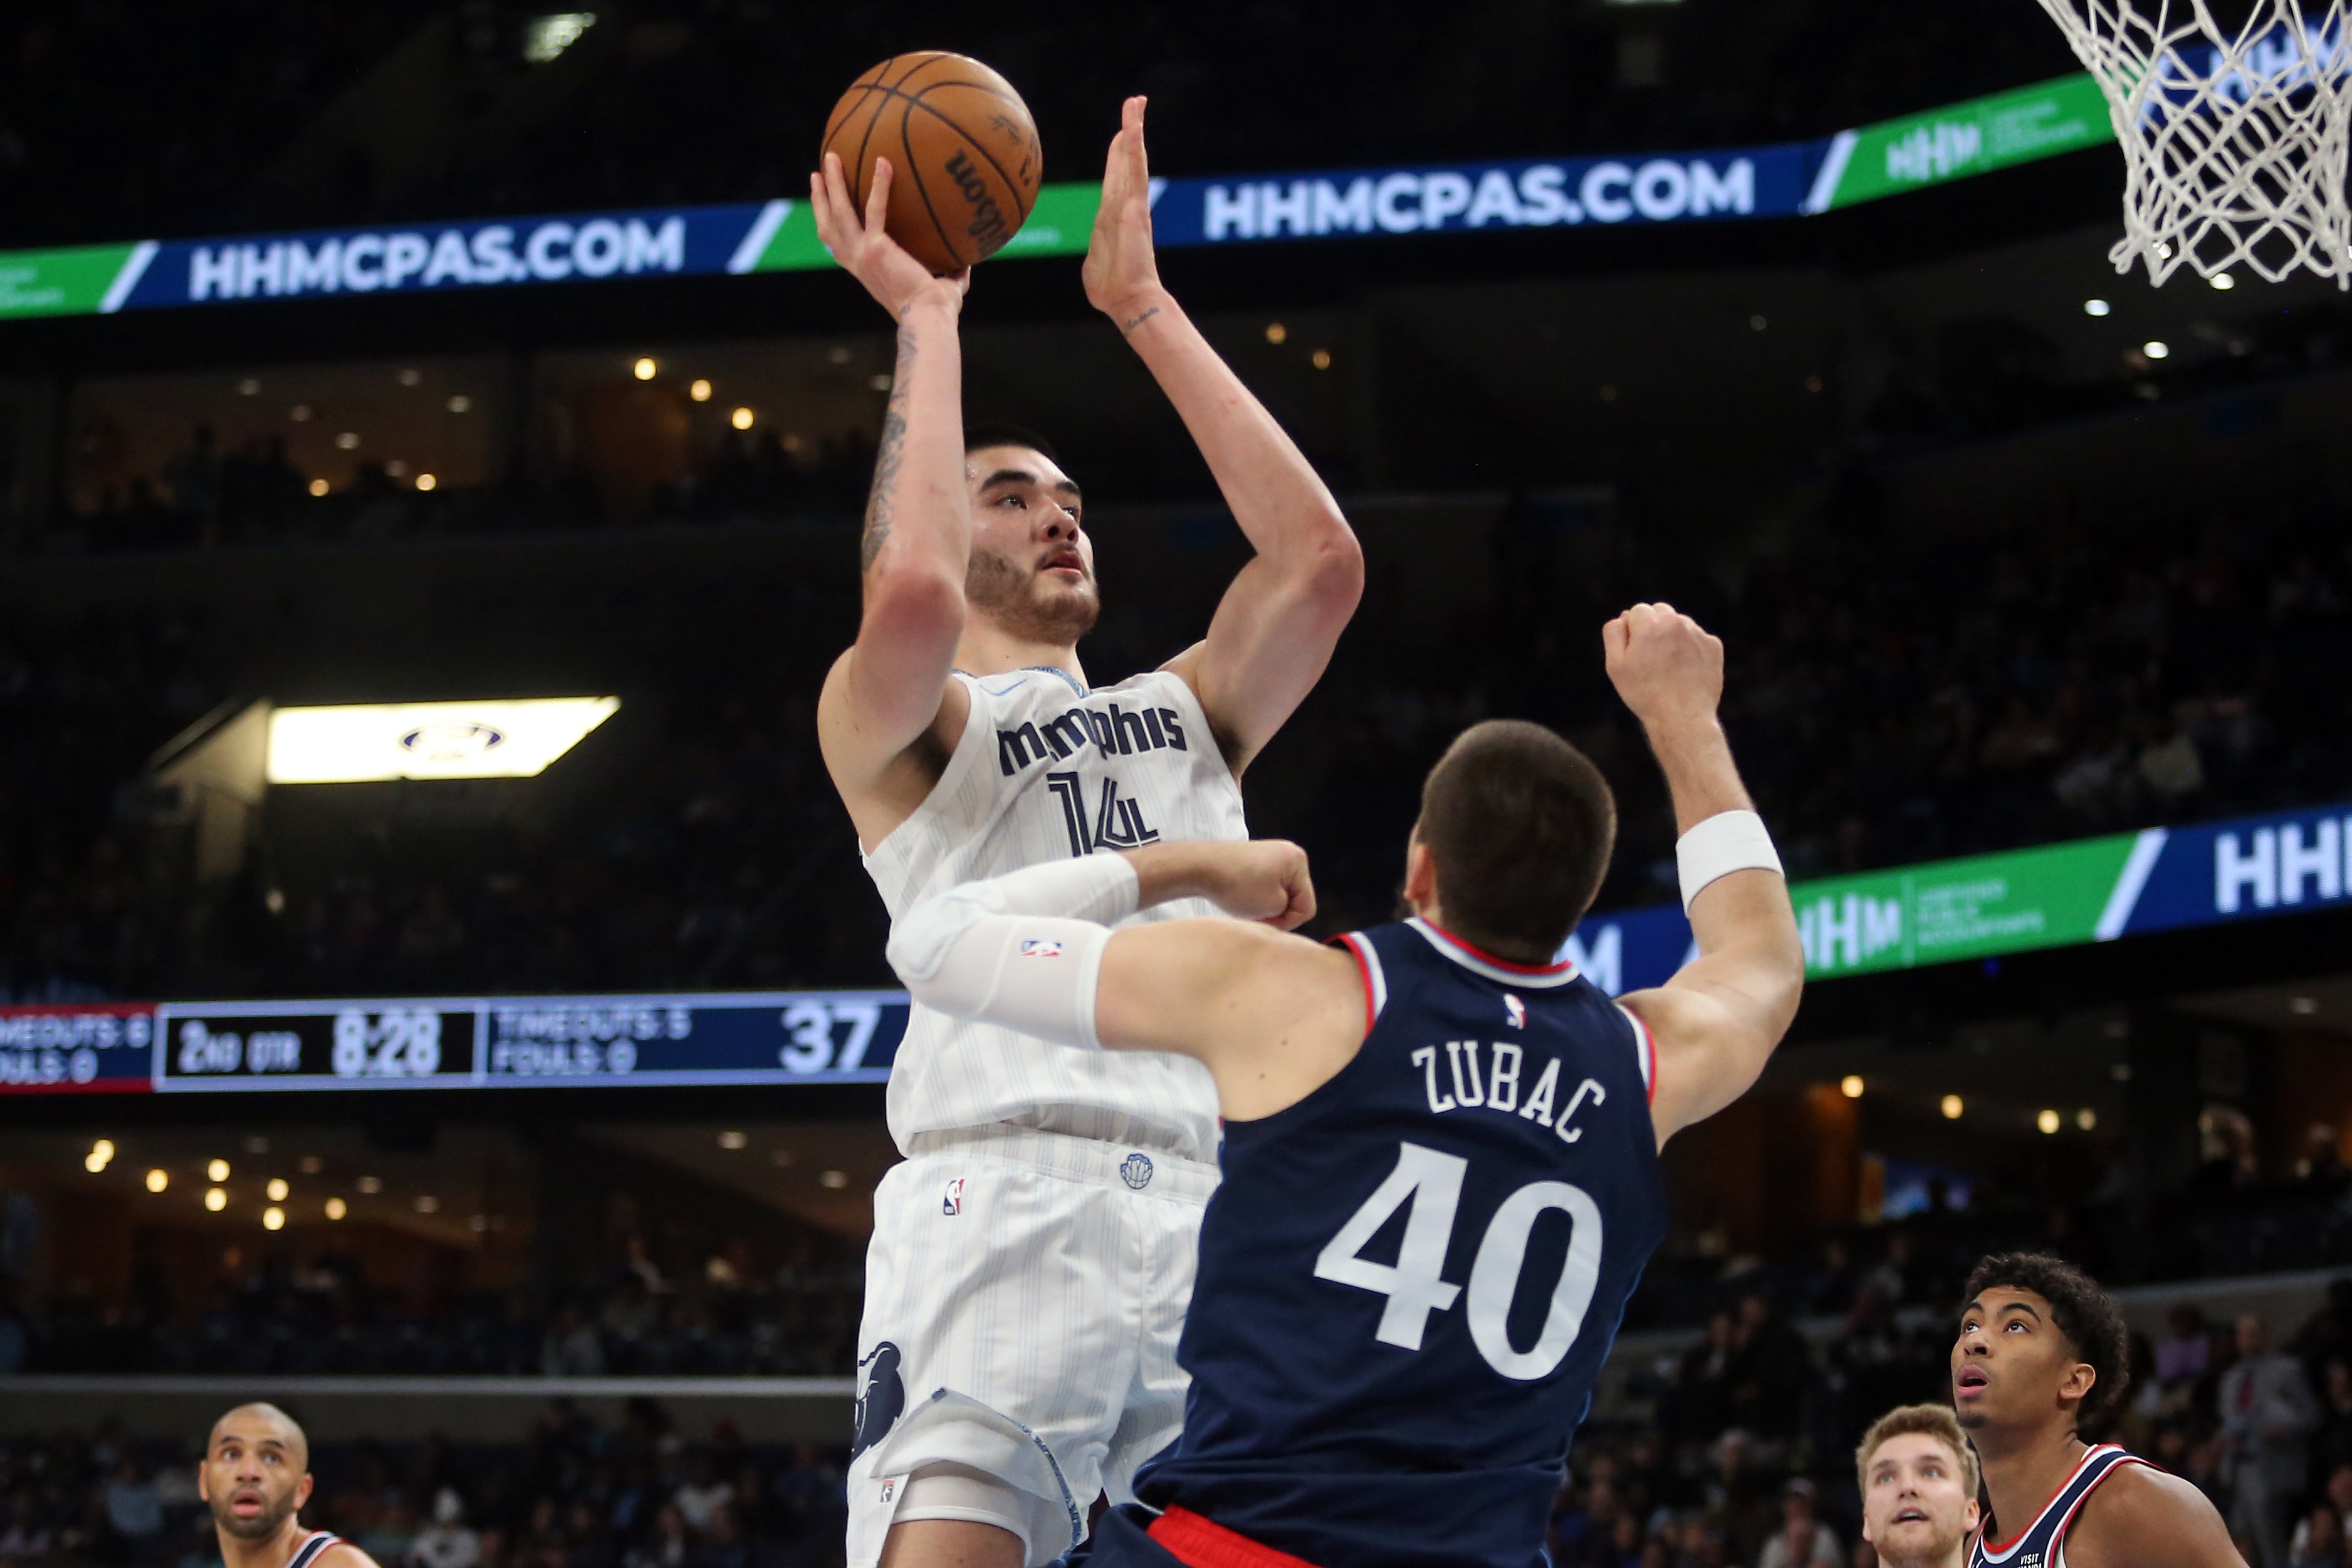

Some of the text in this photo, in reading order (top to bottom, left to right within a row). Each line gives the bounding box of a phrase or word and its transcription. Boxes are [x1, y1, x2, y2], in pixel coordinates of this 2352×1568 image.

[1203, 158, 1754, 241] HHMCPAS.COM
[189, 216, 686, 300] HHMCPAS.COM
[1047, 771, 1161, 857] 14
[2213, 813, 2352, 914] HH
[333, 1006, 442, 1078] 8:28
[779, 1000, 882, 1074] 37
[1411, 1040, 1606, 1143] ZUBAC
[1314, 1141, 1604, 1381] 40
[2020, 1553, 2039, 1565] VISIT
